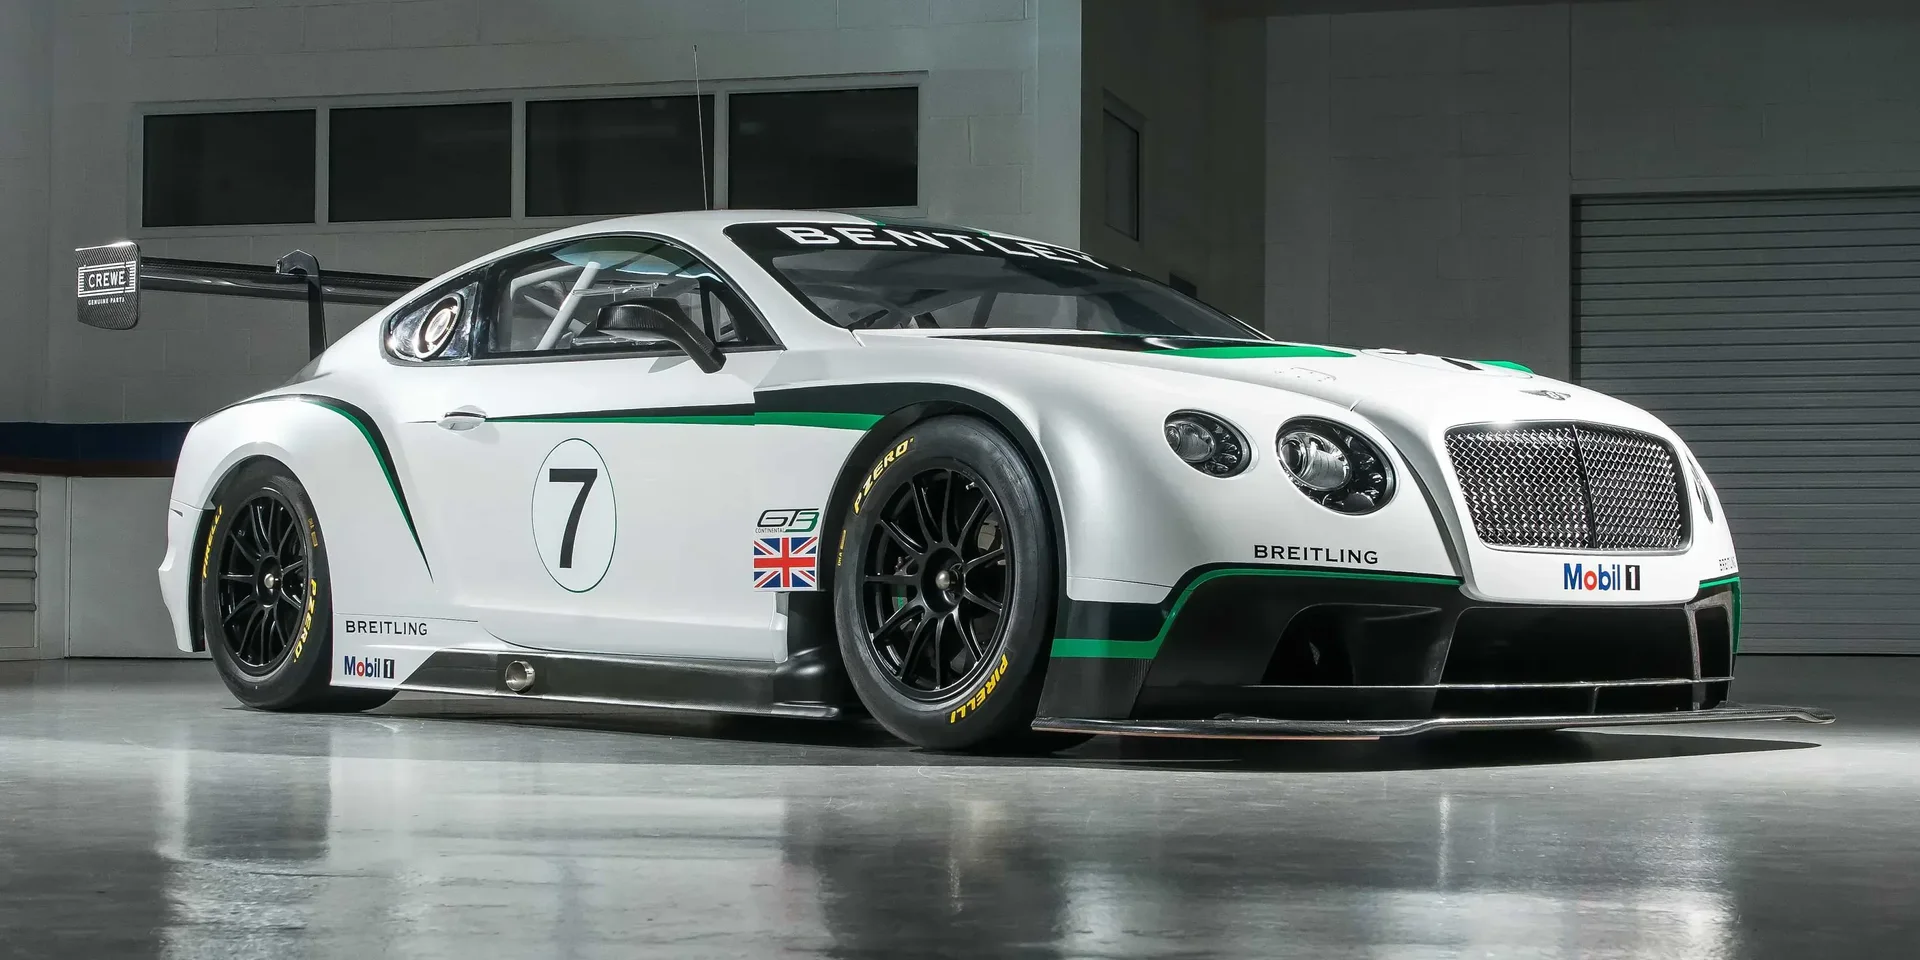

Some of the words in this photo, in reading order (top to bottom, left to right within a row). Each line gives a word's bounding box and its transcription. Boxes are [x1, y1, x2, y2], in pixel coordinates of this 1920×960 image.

[776, 226, 1109, 270] BENTLEY
[88, 270, 127, 288] CREWE
[88, 298, 109, 306] GENUINE
[549, 468, 598, 568] 7
[757, 508, 819, 532] GT3
[203, 505, 222, 578] PIRELLI
[1254, 544, 1378, 565] BREITLING
[1563, 563, 1621, 591] Mobil
[1625, 564, 1641, 591] 1
[346, 620, 428, 636] BREITLING
[344, 655, 381, 678] Mobil
[383, 658, 395, 679] 1
[950, 653, 1009, 724] PIRELLI
